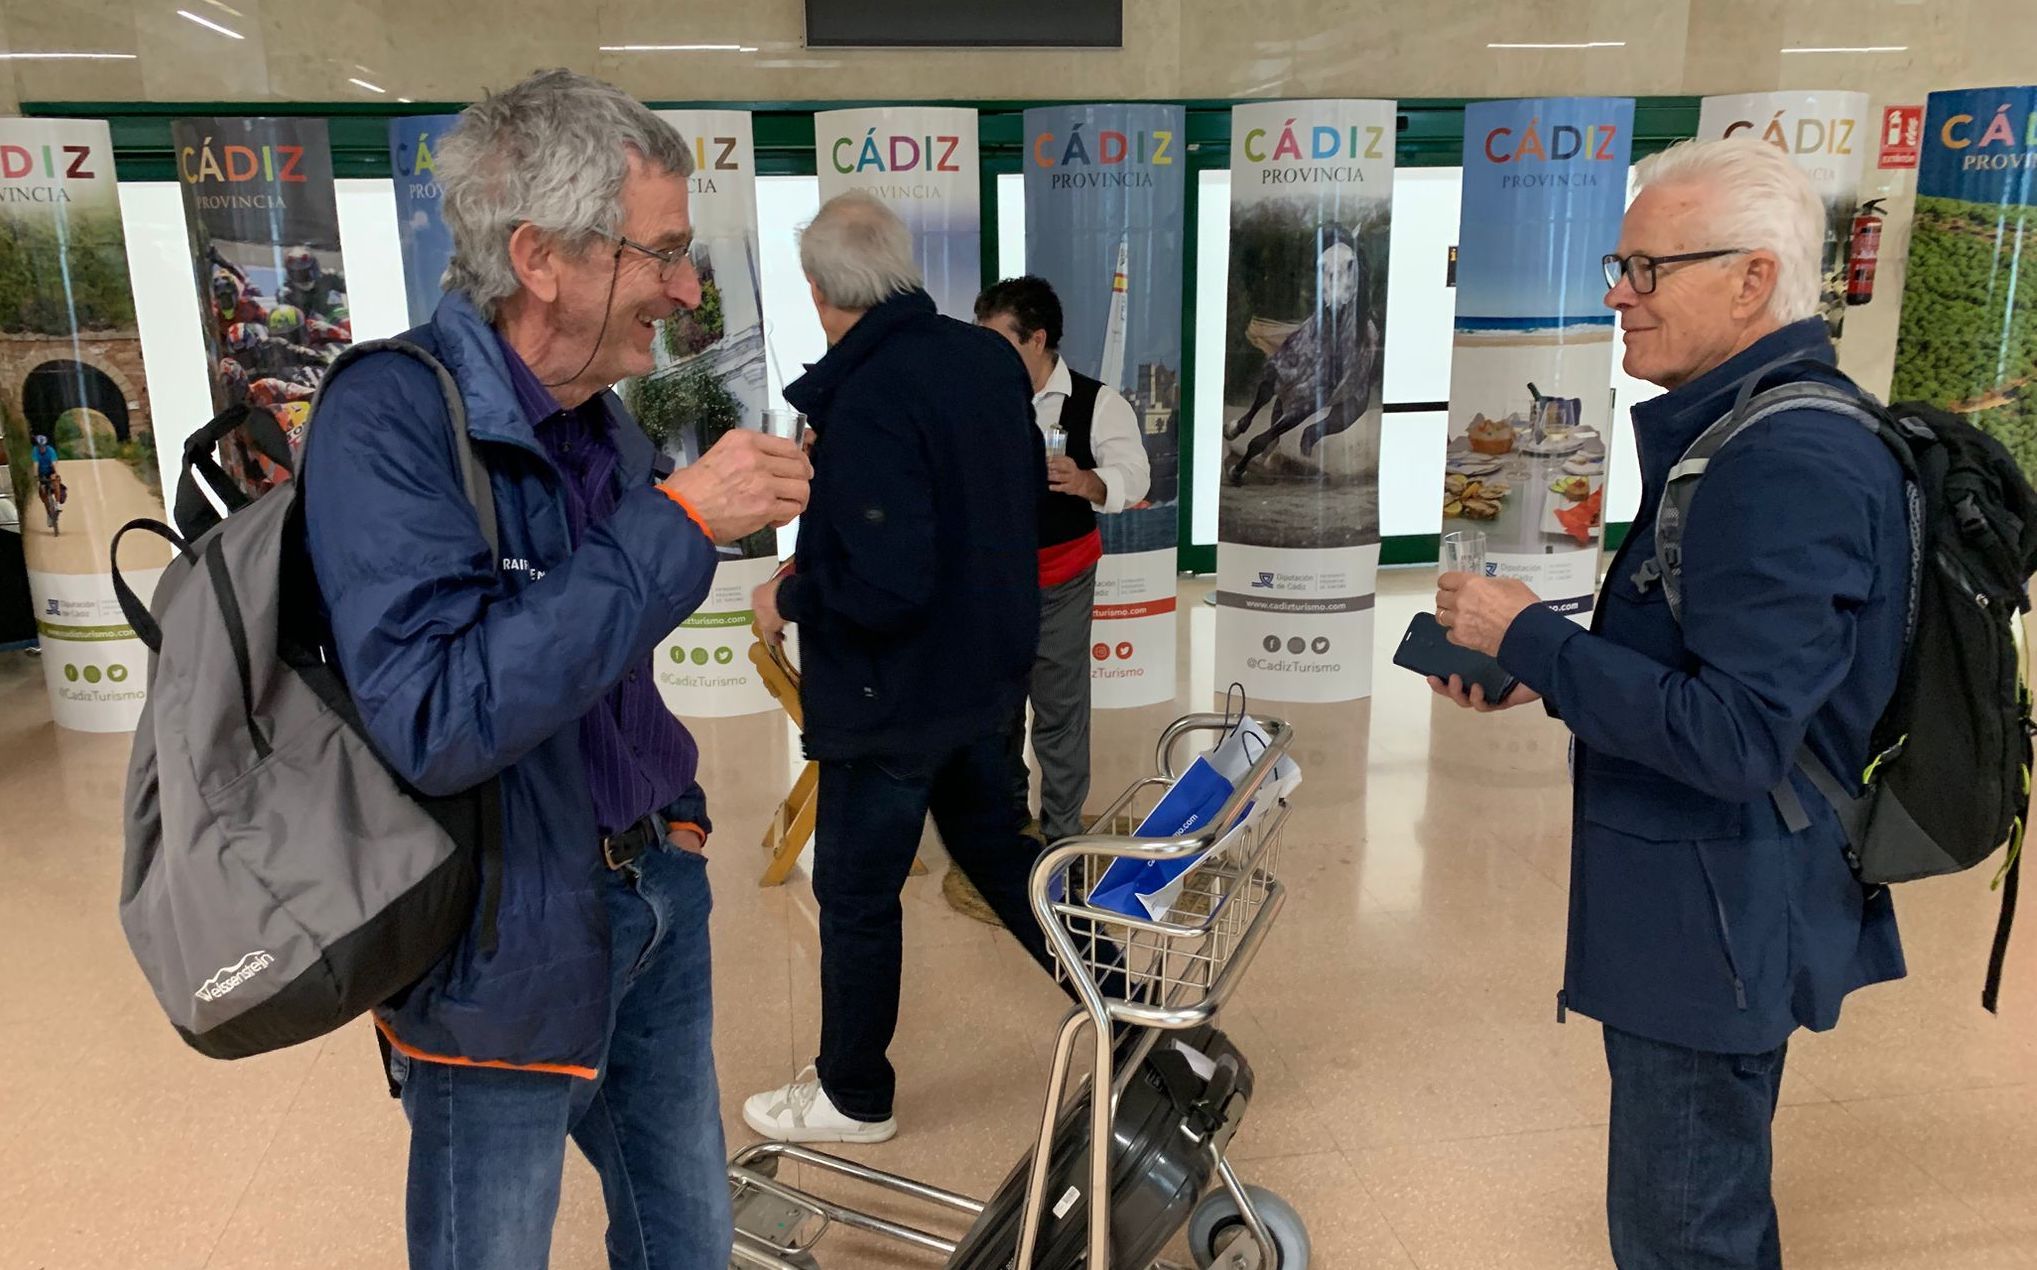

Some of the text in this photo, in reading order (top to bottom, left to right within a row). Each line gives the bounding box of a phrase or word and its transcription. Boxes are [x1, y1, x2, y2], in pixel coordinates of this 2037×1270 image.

[1033, 123, 1173, 168] CÁDIZ
[1244, 118, 1384, 164] CÁDIZ
[1485, 116, 1616, 163] CÁDIZ
[832, 127, 960, 174] CÁDIZ
[0, 145, 95, 178] DIZ
[182, 136, 308, 184] CÁDIZ
[1051, 172, 1153, 189] PROVINCIA
[1262, 166, 1365, 185] PROVINCIA
[1502, 174, 1597, 189] PROVINCIA
[0, 186, 71, 202] VINCIA
[197, 195, 288, 209] PROVINCIA
[1246, 600, 1347, 611] www.cadizturismo.com
[1091, 667, 1144, 679] zTurismo
[1247, 657, 1341, 673] @CadizTurismo
